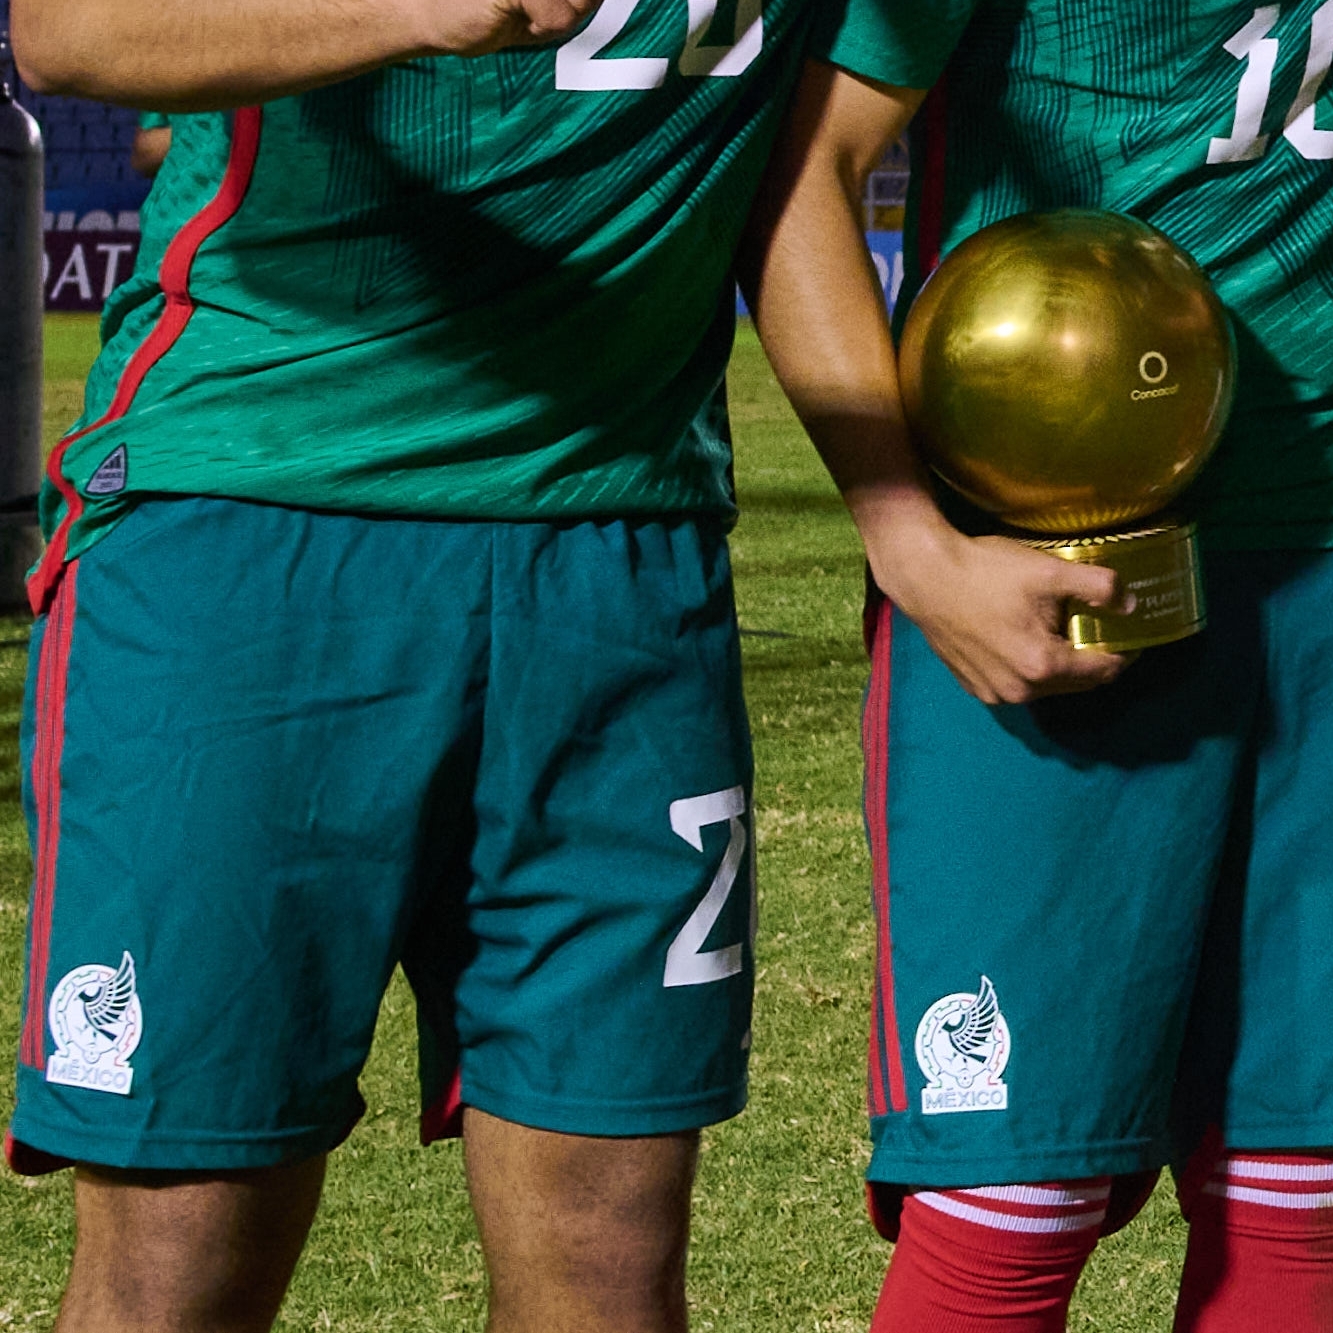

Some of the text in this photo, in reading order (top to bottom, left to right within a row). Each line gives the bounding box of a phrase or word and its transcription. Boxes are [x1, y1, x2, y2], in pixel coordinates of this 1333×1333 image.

[1130, 384, 1180, 401] Concacaf
[663, 785, 757, 988] 2
[52, 1059, 127, 1089] MÉXICO
[926, 1088, 1004, 1109] MÉXICO
